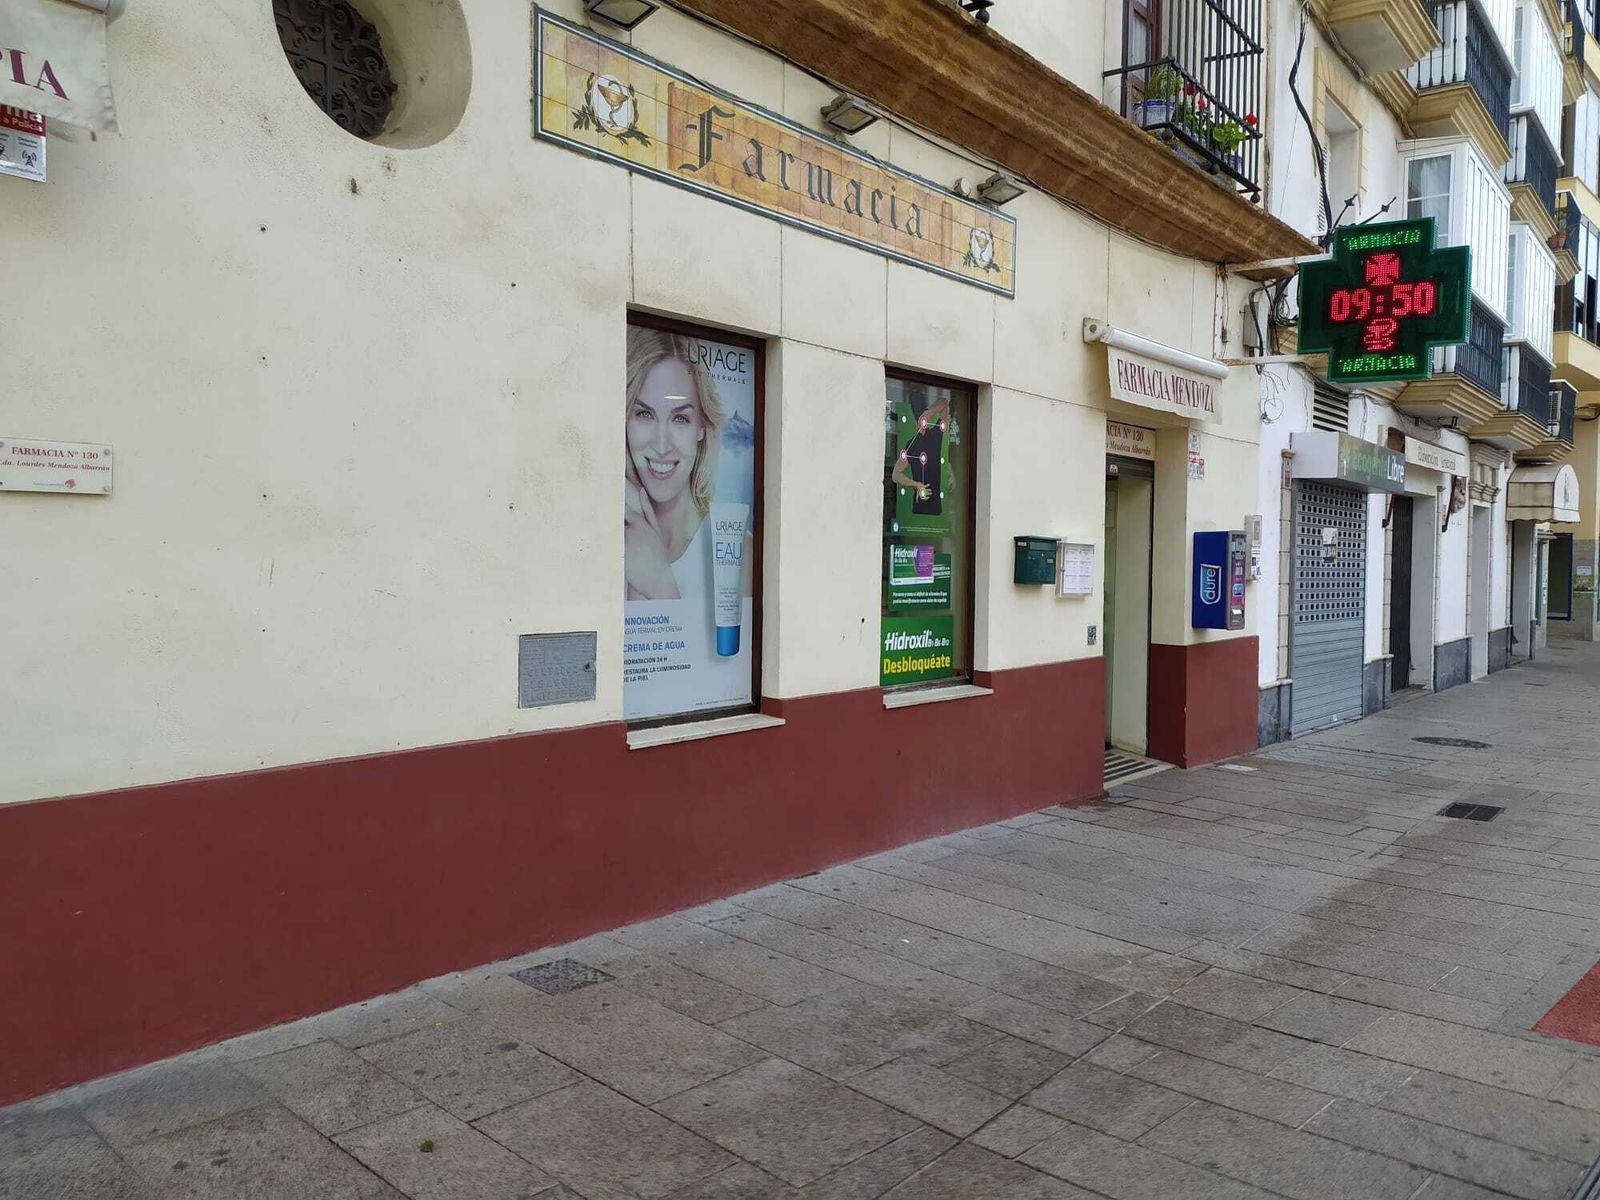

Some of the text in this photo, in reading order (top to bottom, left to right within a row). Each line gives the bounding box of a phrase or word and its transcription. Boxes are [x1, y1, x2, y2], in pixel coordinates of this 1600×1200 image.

[677, 106, 922, 240] Farmacia
[1330, 281, 1435, 322] 09:50
[687, 342, 747, 373] URIAGE
[1116, 358, 1171, 402] FARMACIA
[11, 446, 65, 458] FARMACIA
[82, 451, 99, 460] 130
[17, 460, 46, 468] Lourdes
[715, 542, 743, 559] EAU
[652, 642, 663, 651] DE
[665, 641, 686, 650] AGUA
[885, 629, 929, 652] Hidroxil
[883, 653, 951, 675] Desbloquéate
